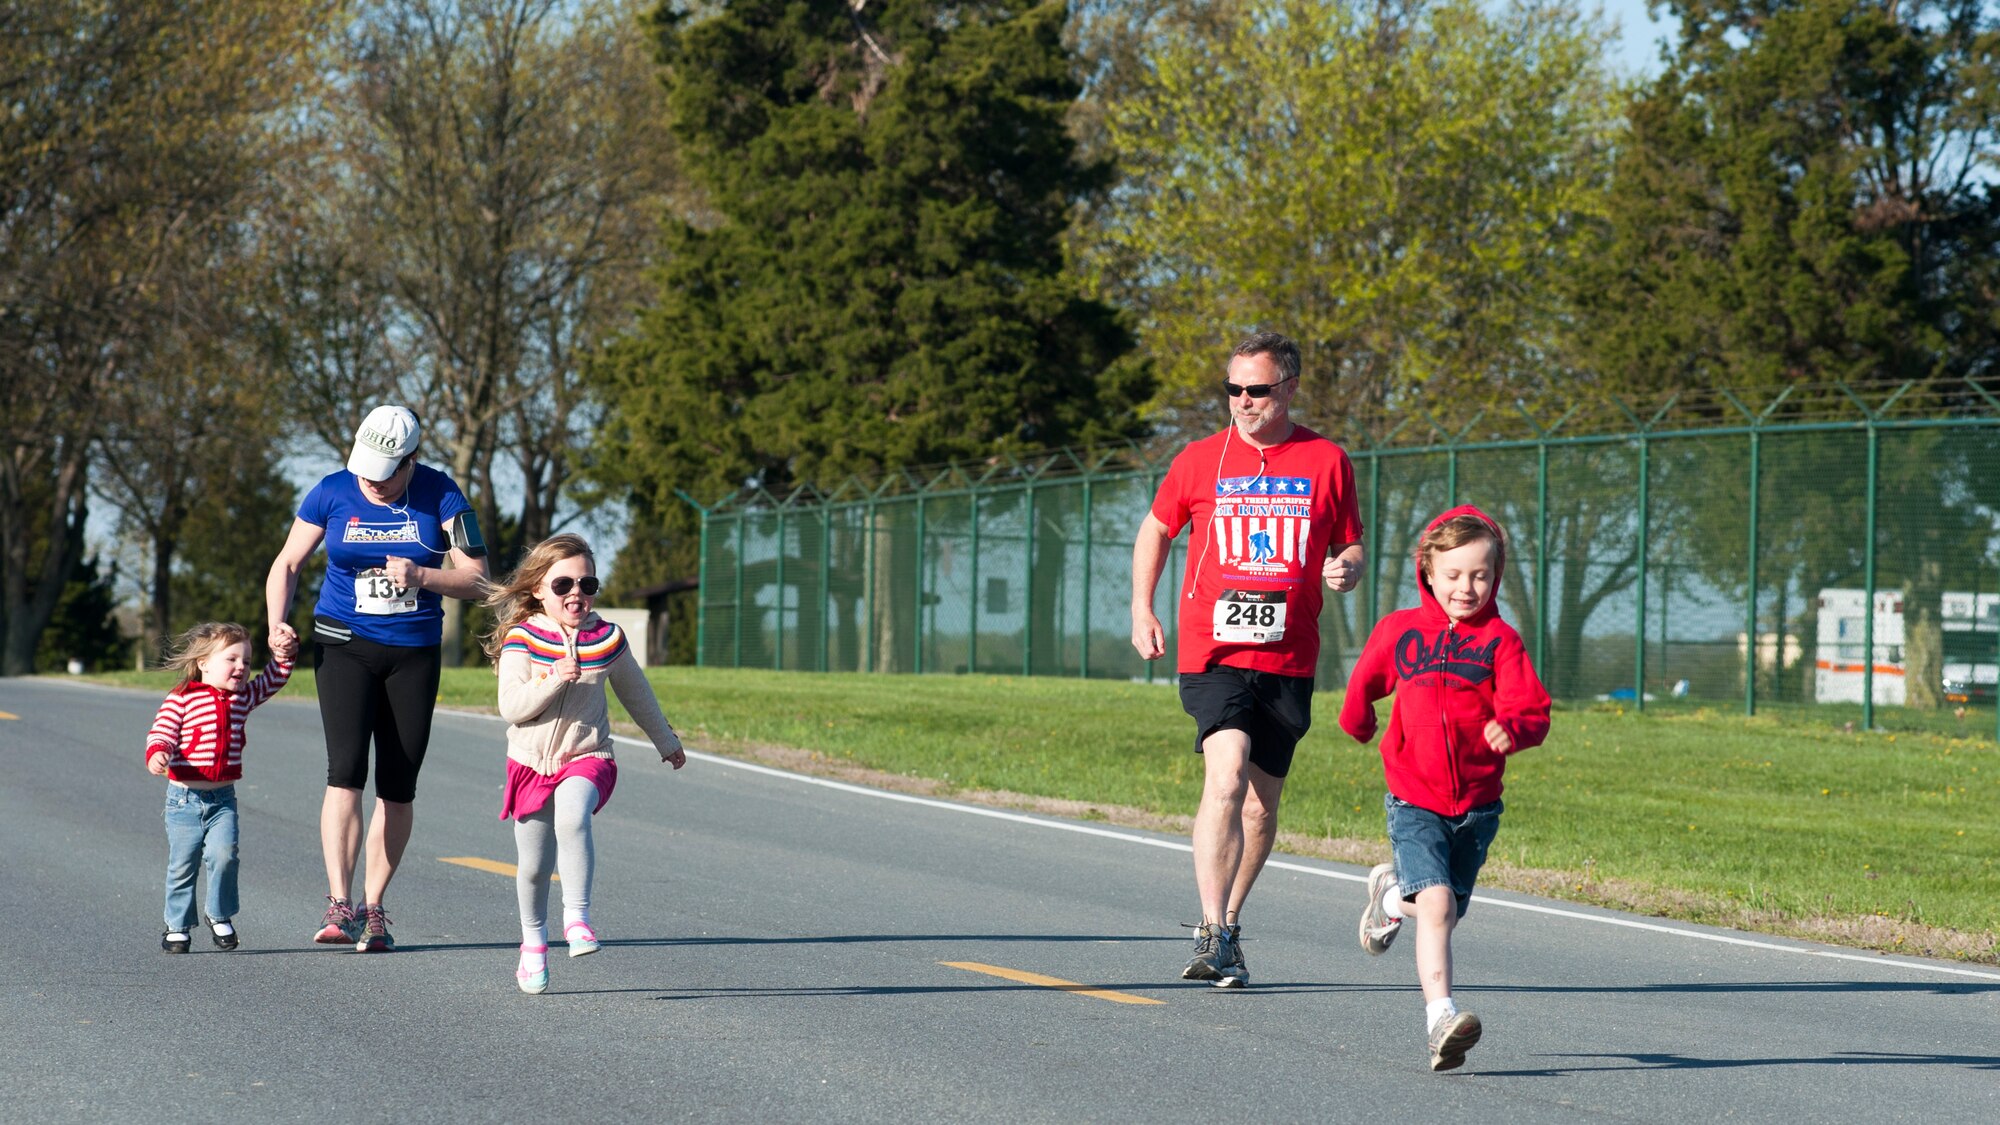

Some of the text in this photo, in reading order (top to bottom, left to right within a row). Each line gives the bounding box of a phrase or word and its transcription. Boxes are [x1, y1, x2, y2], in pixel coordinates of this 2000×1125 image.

[363, 429, 397, 449] OHIO
[1244, 497, 1269, 505] THEIR
[1271, 497, 1311, 505] SACRIFICE
[1216, 504, 1234, 516] 5K
[1225, 603, 1275, 627] 248
